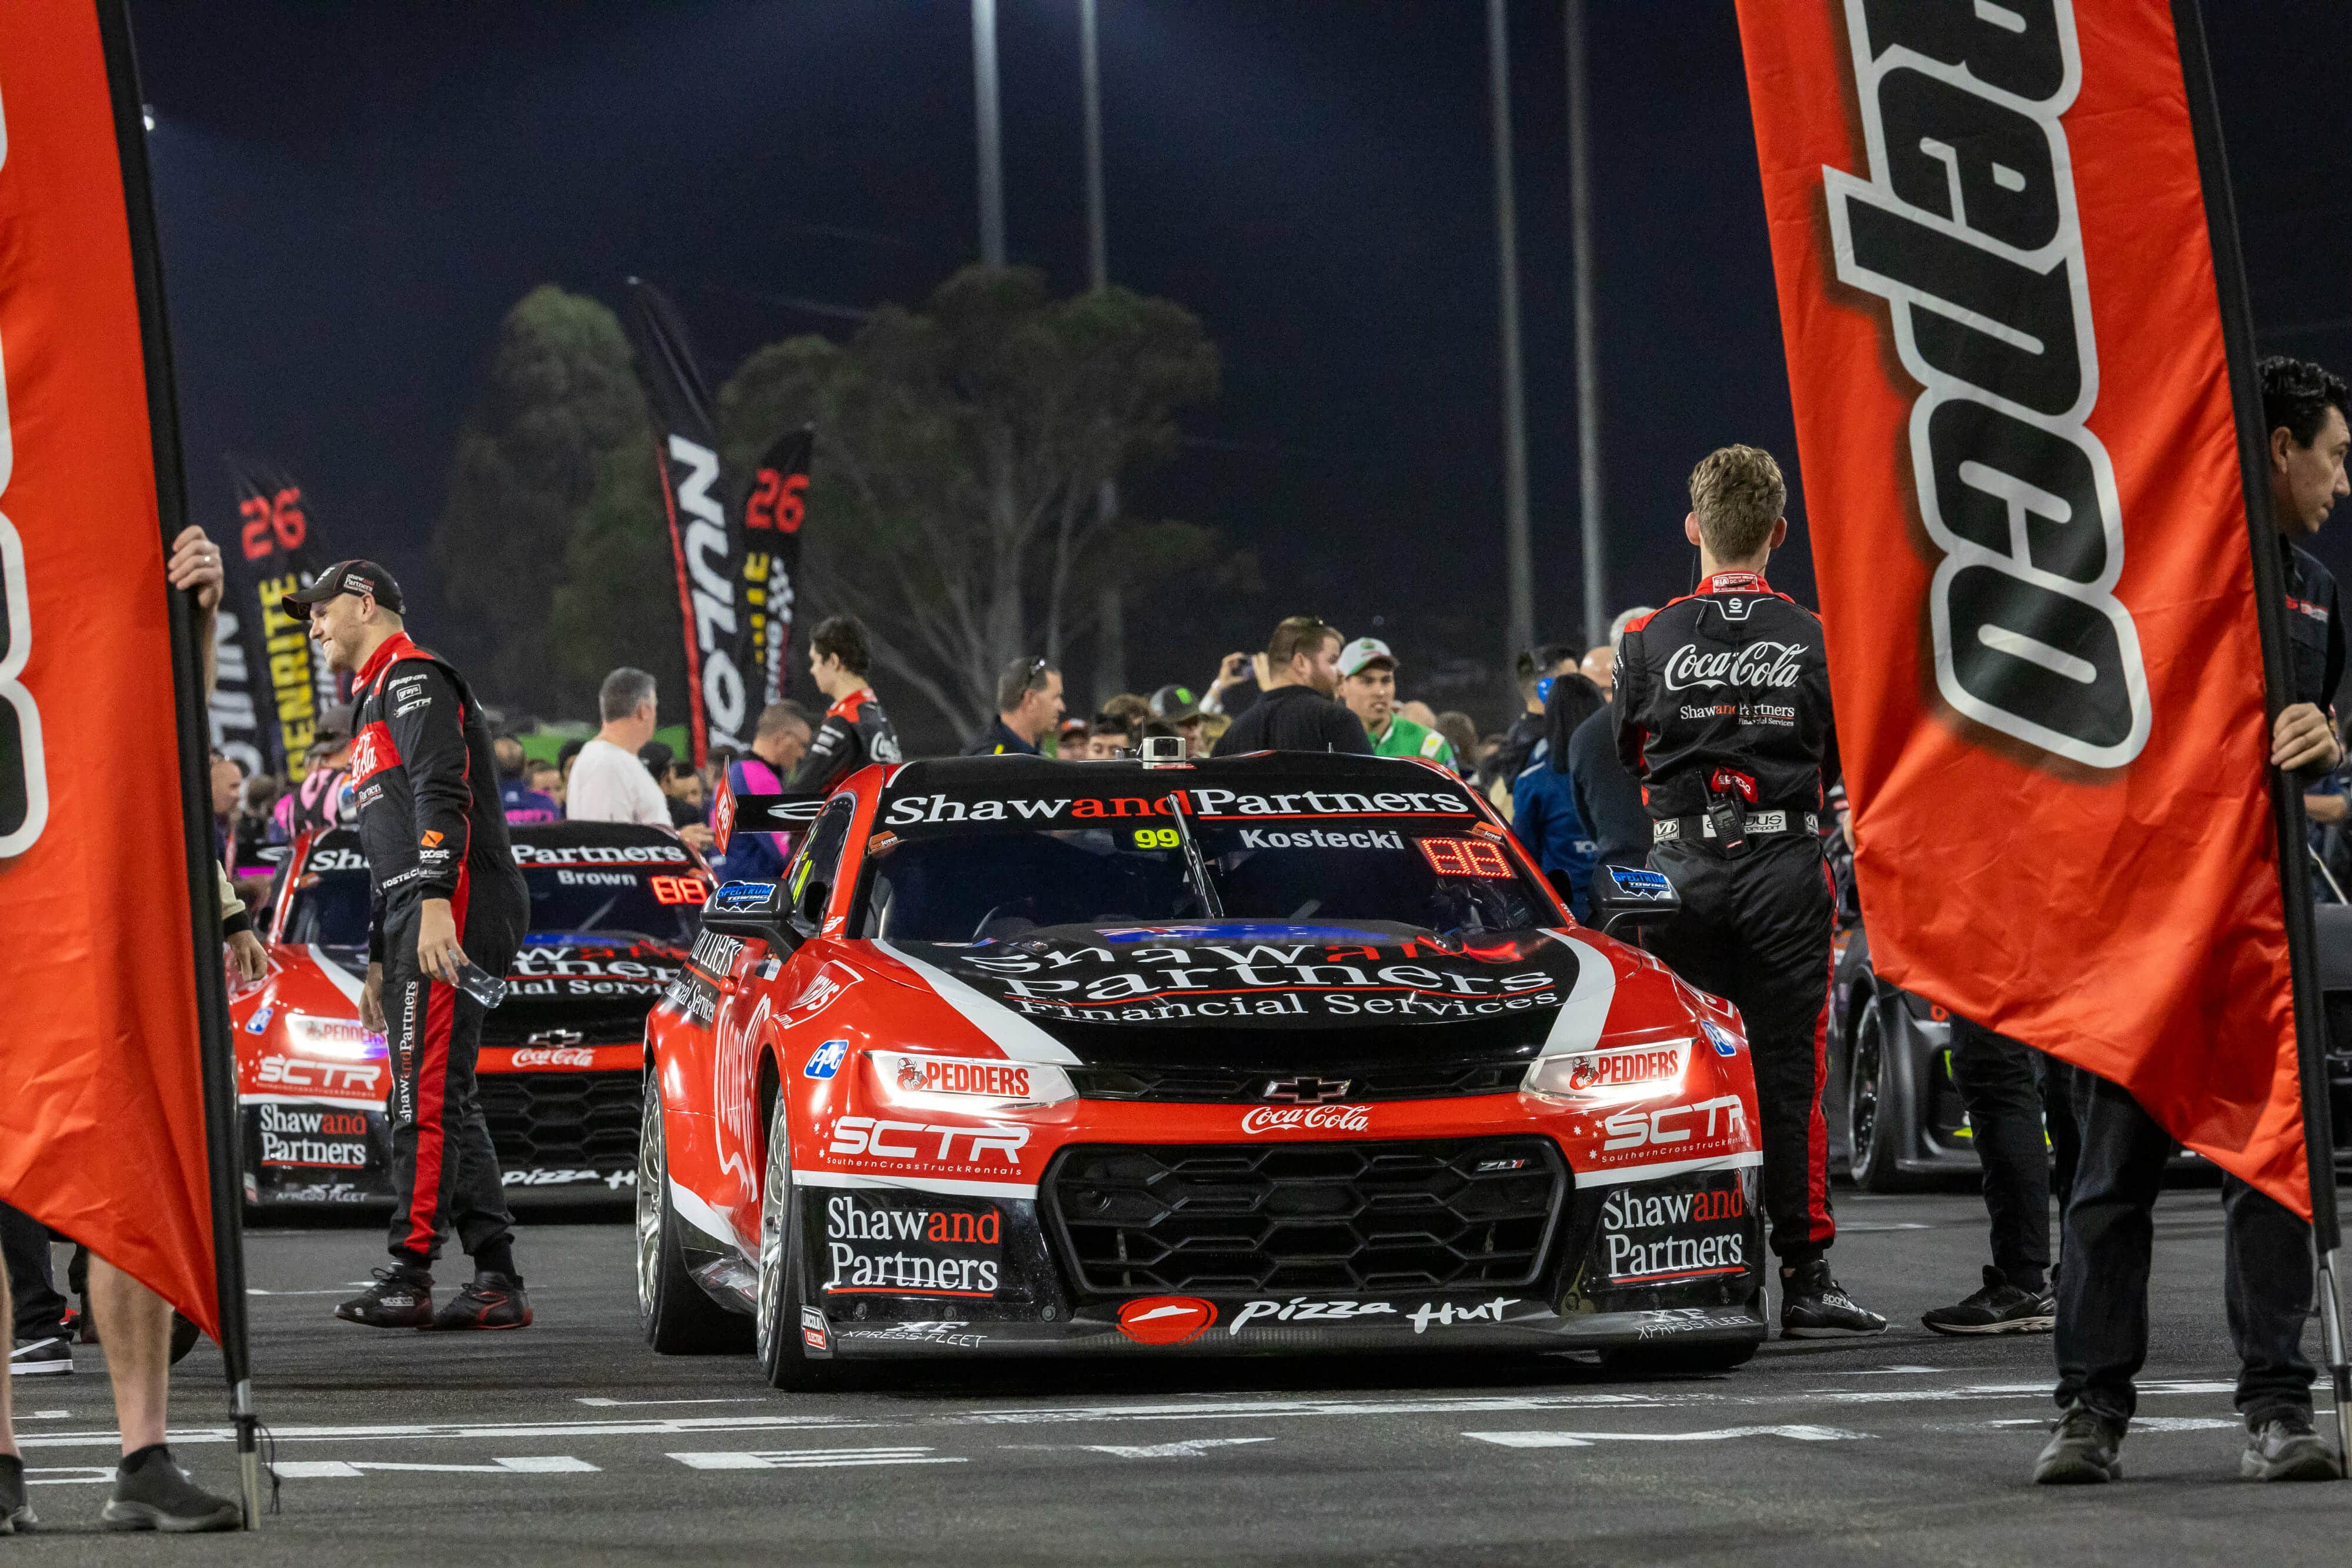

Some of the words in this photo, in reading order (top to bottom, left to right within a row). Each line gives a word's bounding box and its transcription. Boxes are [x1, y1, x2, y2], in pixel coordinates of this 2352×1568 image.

[746, 469, 809, 533] 26
[239, 488, 306, 560] 26
[1665, 641, 1809, 691] Coca-Cola
[1768, 718, 1794, 726] Services
[1134, 828, 1180, 849] 99
[1240, 829, 1405, 850] Kostecki
[1421, 838, 1512, 878] 88
[557, 869, 637, 887] Brown
[650, 875, 707, 905] 88
[718, 883, 774, 898] SPECTRUM
[1612, 871, 1666, 884] SPECTRUM
[993, 964, 1555, 1000] Partners
[687, 984, 716, 1024] Services
[1014, 993, 1309, 1022] Financial
[1324, 991, 1558, 1016] Services
[258, 1056, 382, 1091] SCTR
[512, 1048, 596, 1068] Coca-Cola
[1598, 1049, 1680, 1084] PEDDERS
[926, 1062, 1030, 1096] PEDDERS
[260, 1104, 367, 1135] Shawand
[1241, 1105, 1374, 1135] Coca-Cola
[1603, 1094, 1748, 1151] SCTR
[261, 1132, 367, 1165] Partners
[829, 1115, 1030, 1164] SCTR
[827, 1156, 1022, 1176] SouthernCrossTruckRentals
[1478, 1159, 1525, 1172] ZL1
[1603, 1174, 1744, 1231] Shawand
[828, 1196, 1000, 1245] Shawand
[828, 1242, 998, 1292] Partners
[1606, 1233, 1743, 1278] Partners
[802, 1312, 821, 1330] LINCOLN
[1702, 1315, 1754, 1328] FLEET
[806, 1330, 824, 1346] ELECTRIC
[842, 1330, 922, 1340] XPRESS
[924, 1333, 988, 1348] FLEET
